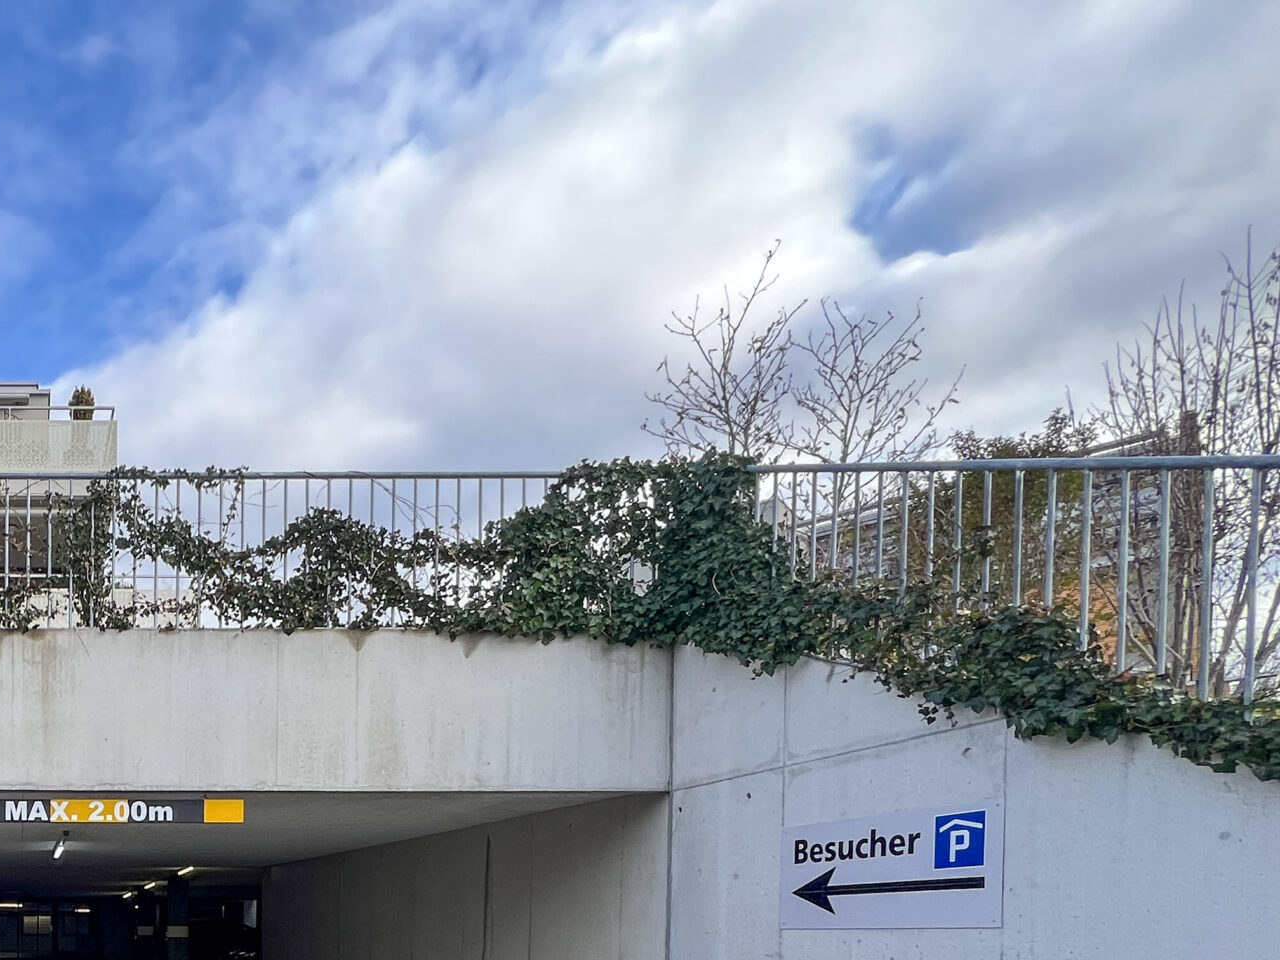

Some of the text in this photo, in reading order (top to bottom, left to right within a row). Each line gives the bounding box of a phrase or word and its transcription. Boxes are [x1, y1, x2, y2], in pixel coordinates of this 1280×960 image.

[4, 800, 173, 822] MAX. 2.00m
[793, 828, 970, 865] Besucher P
